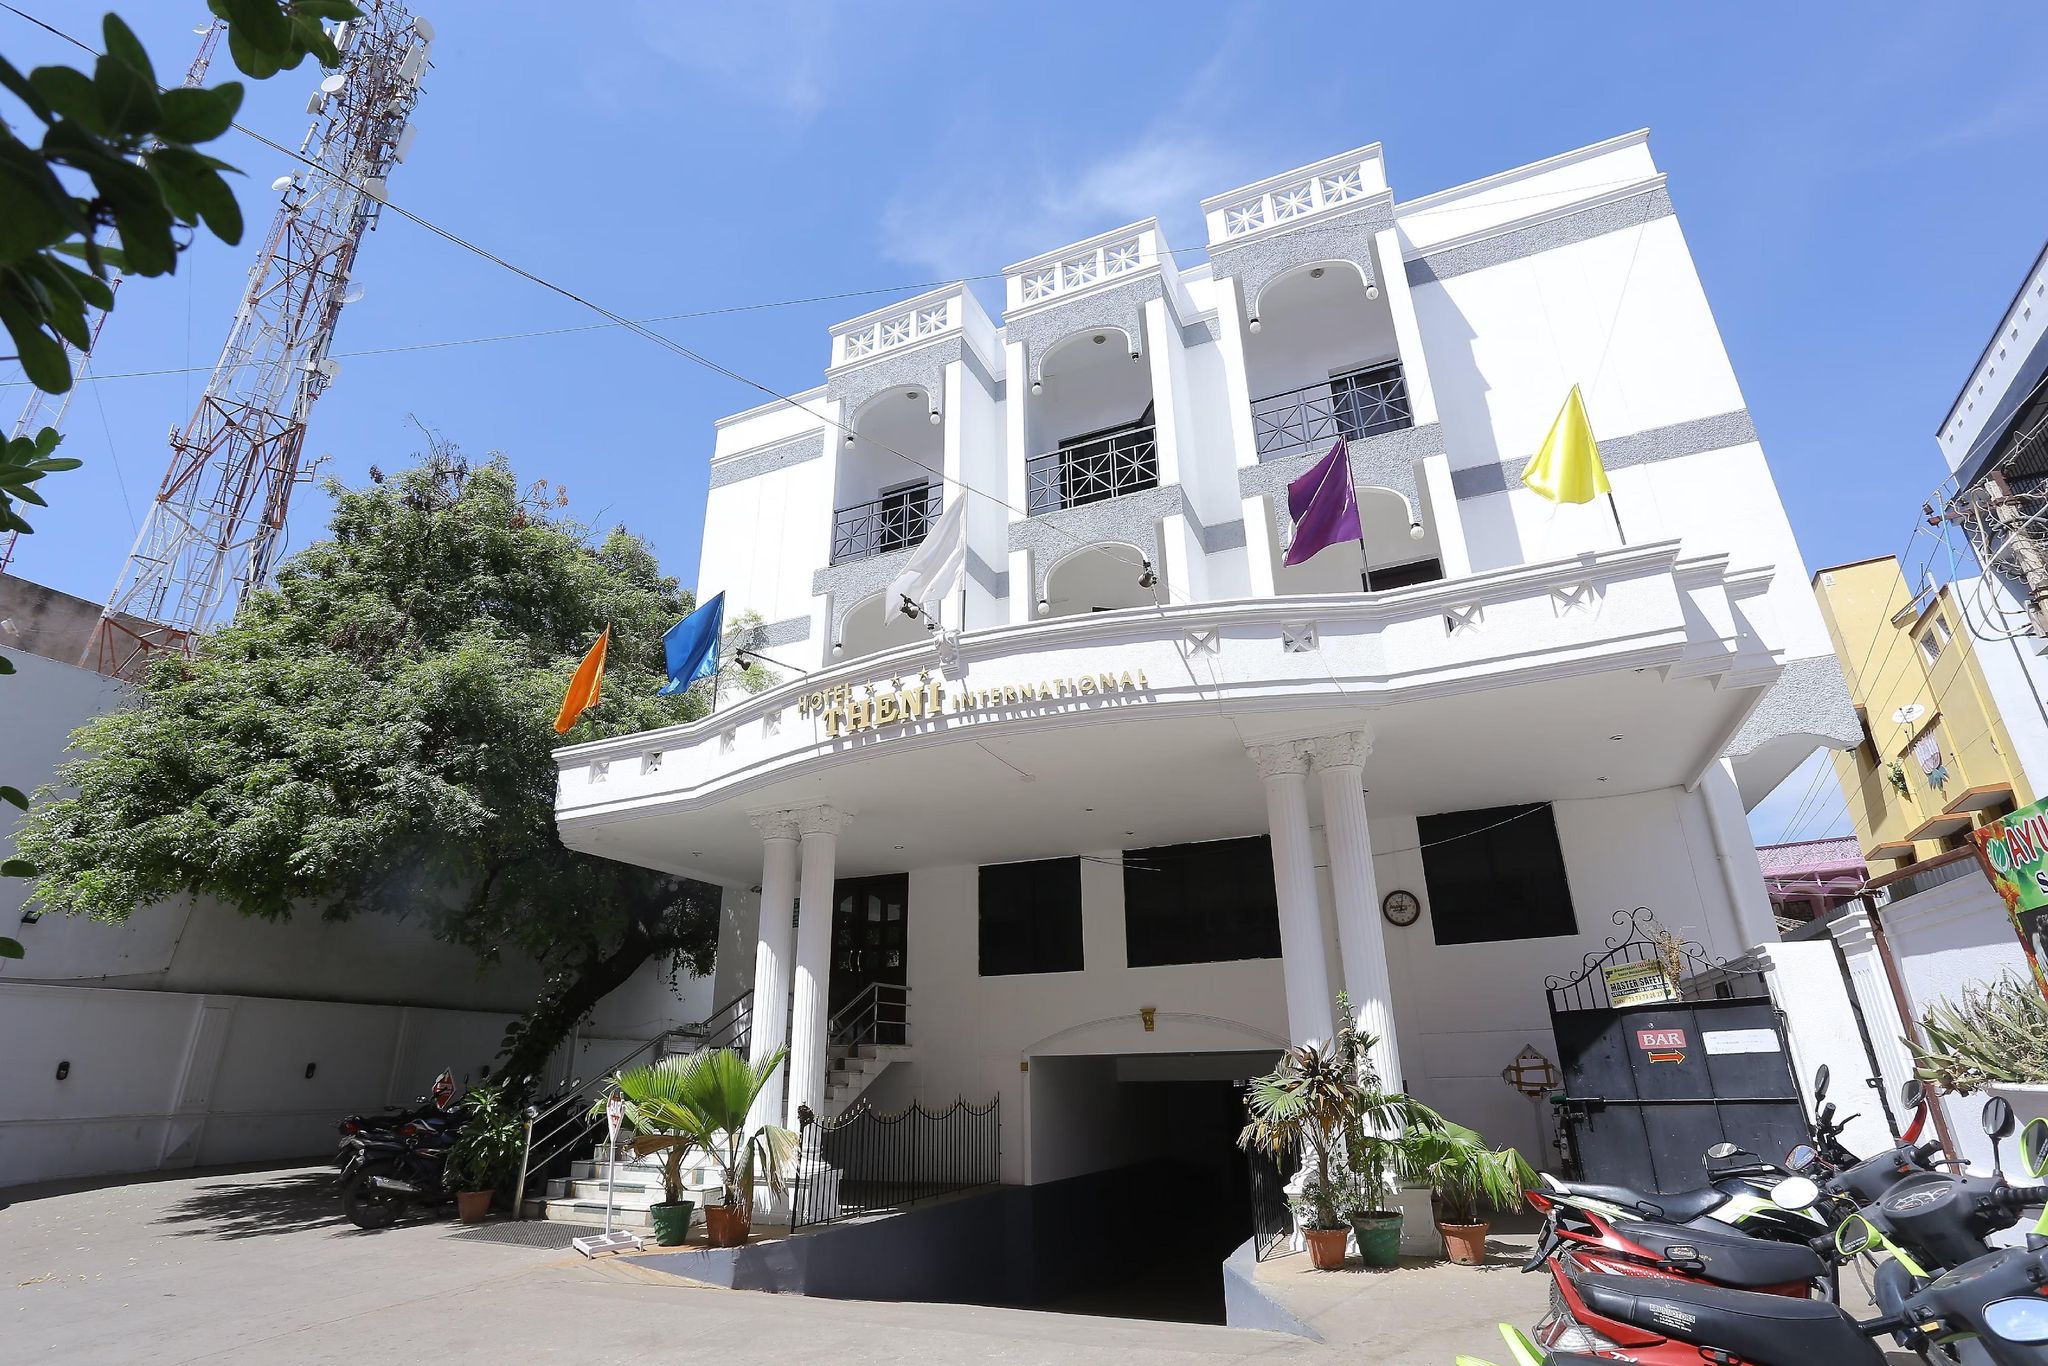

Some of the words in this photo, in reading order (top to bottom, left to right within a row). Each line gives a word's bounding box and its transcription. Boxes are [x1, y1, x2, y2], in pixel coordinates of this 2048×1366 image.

[798, 683, 852, 713] HOTEL
[823, 682, 942, 737] THENI
[953, 668, 1149, 709] INTERNATIONAL
[2004, 810, 2048, 869] AYU
[1610, 979, 1638, 992] MASTER
[1639, 974, 1665, 987] SAFET
[1642, 1033, 1682, 1046] BAR
